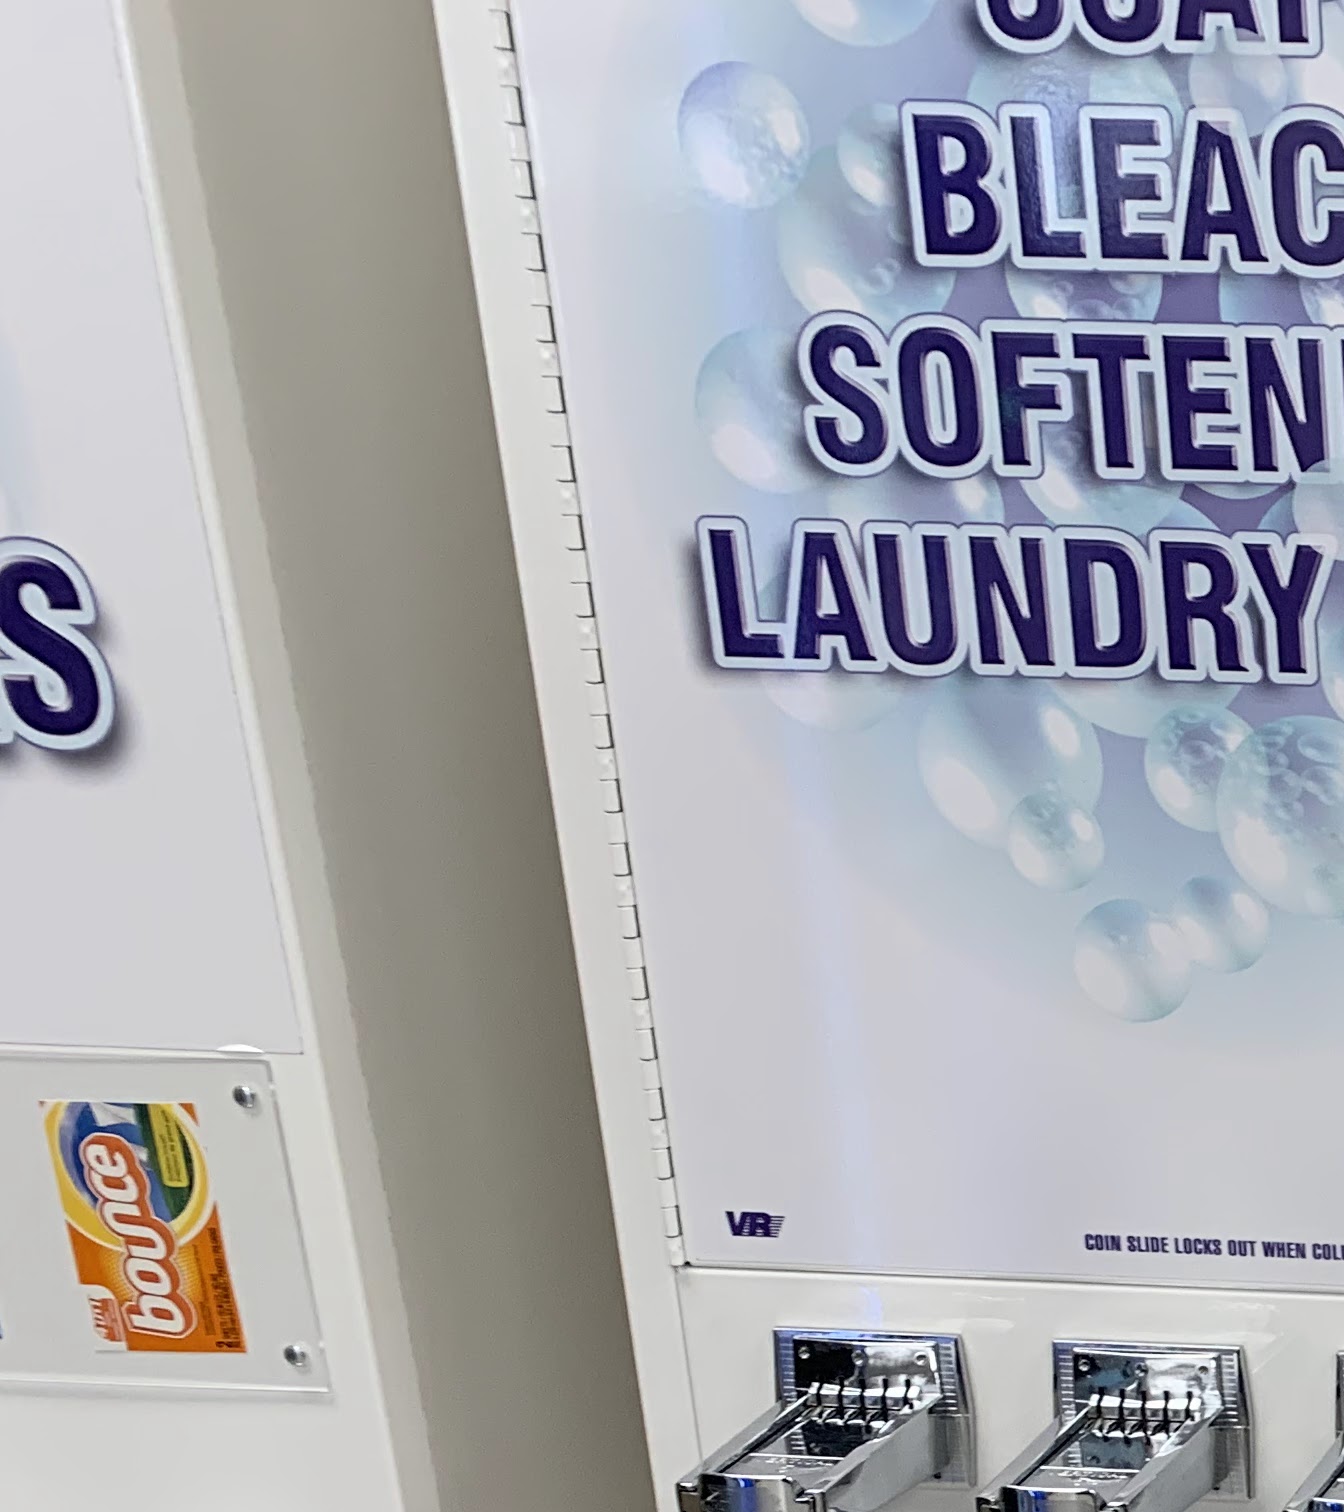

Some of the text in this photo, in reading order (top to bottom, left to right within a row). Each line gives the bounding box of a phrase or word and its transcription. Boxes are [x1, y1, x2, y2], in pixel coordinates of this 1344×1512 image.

[709, 525, 1324, 676] LAUNDRY
[86, 1142, 186, 1334] bounce
[1085, 1233, 1121, 1251] COIN
[1127, 1235, 1169, 1253] SLIDE
[1174, 1237, 1222, 1256] LOCKS
[1228, 1239, 1257, 1257] OUT
[1262, 1241, 1306, 1260] WHEN
